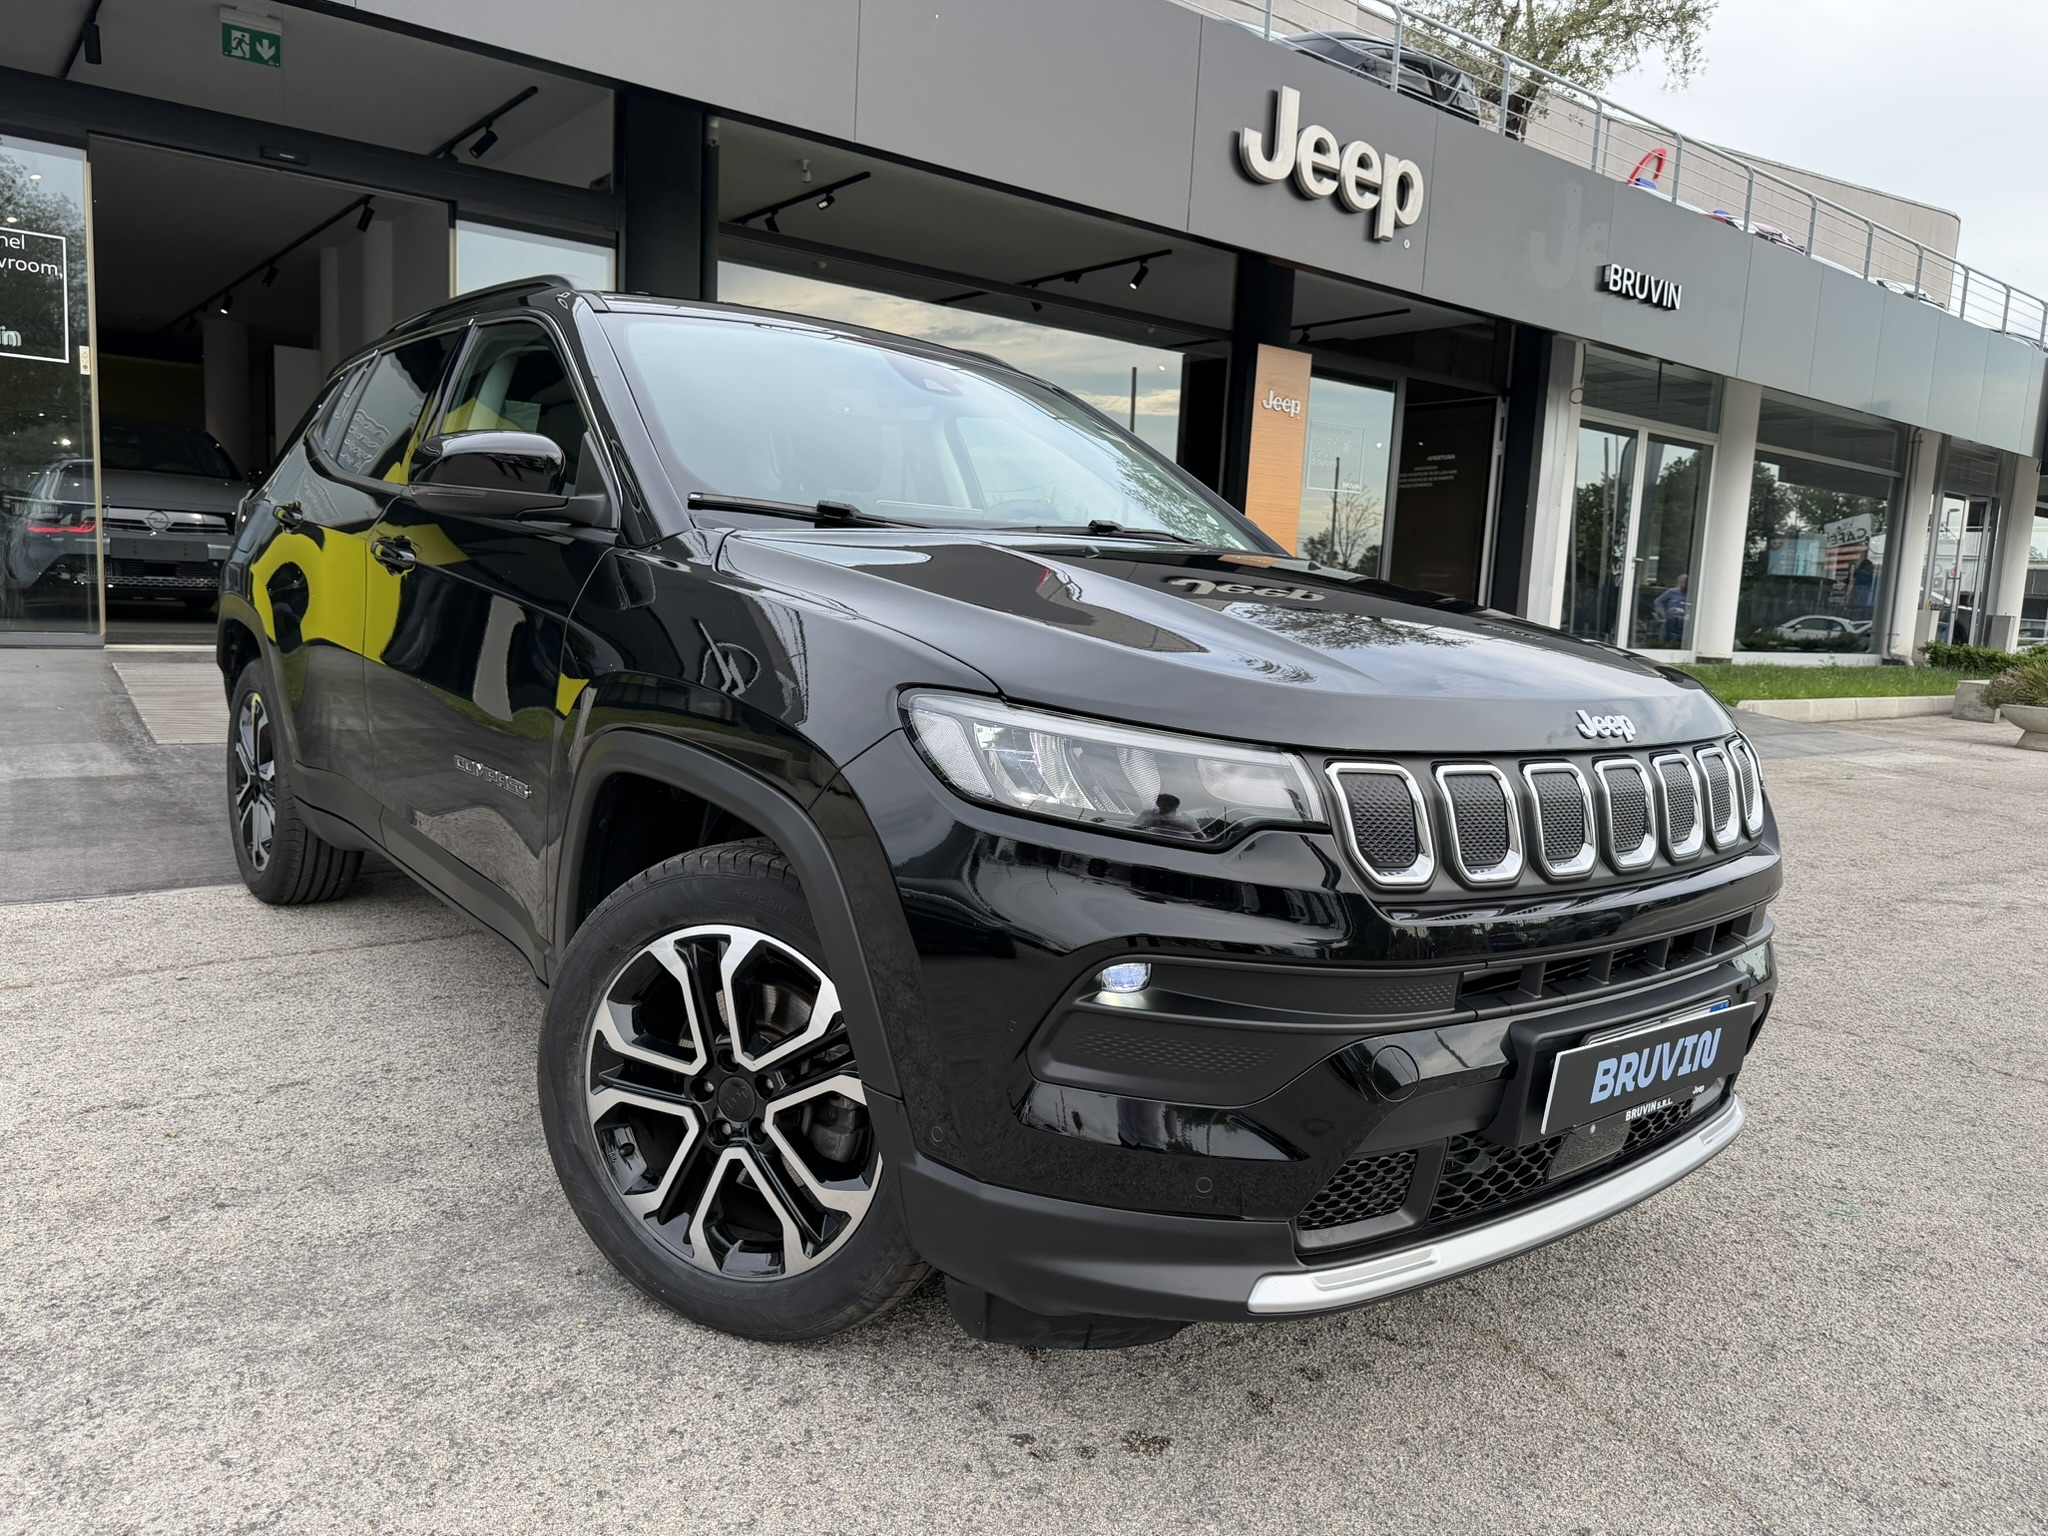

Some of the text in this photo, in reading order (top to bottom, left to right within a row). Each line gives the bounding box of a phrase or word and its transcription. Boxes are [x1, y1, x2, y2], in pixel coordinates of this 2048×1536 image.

[1241, 85, 1424, 242] Jeep
[1608, 263, 1682, 310] BRUVIN
[1262, 390, 1301, 418] Jeep
[1576, 709, 1636, 742] Jeep
[454, 754, 531, 800] COMPASS
[1590, 1027, 1722, 1104] BRUVIN
[1692, 1085, 1705, 1095] Jeep
[1625, 1100, 1657, 1121] BRUVIN
